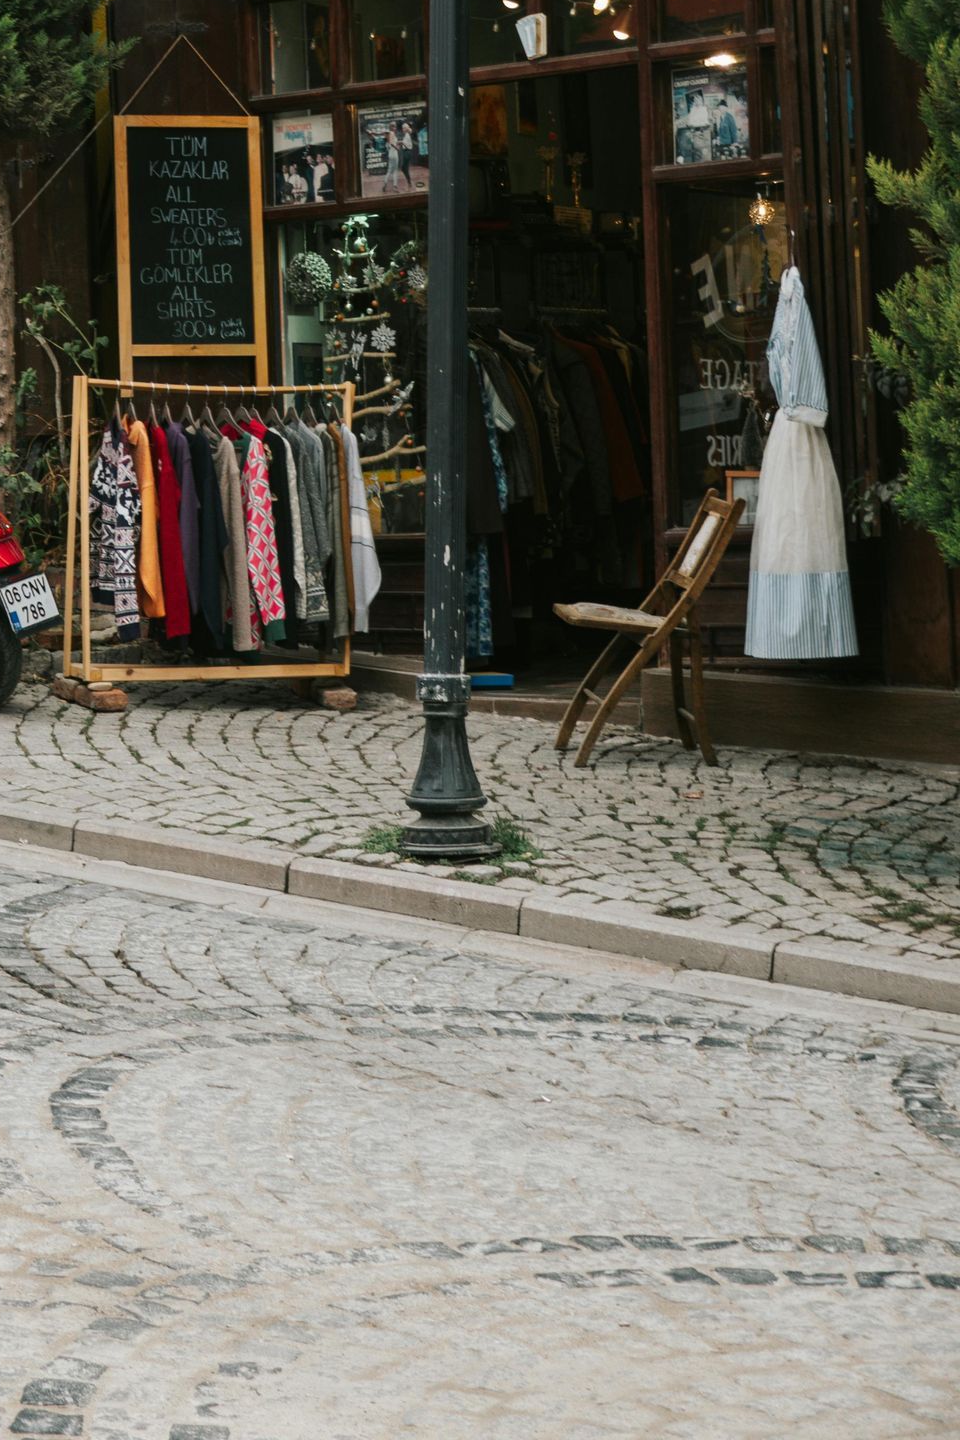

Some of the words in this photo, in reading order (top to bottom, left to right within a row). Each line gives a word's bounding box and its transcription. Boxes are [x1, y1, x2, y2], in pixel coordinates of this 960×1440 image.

[165, 136, 208, 157] TÜM
[149, 160, 230, 180] KAZAKLAR
[166, 185, 197, 203] ALL
[150, 206, 227, 228] SWEATERS
[171, 286, 202, 301] ALL
[157, 300, 216, 320] SHIRTS
[4, 587, 21, 605] 06
[21, 576, 46, 599] CNV
[22, 602, 46, 623] 786
